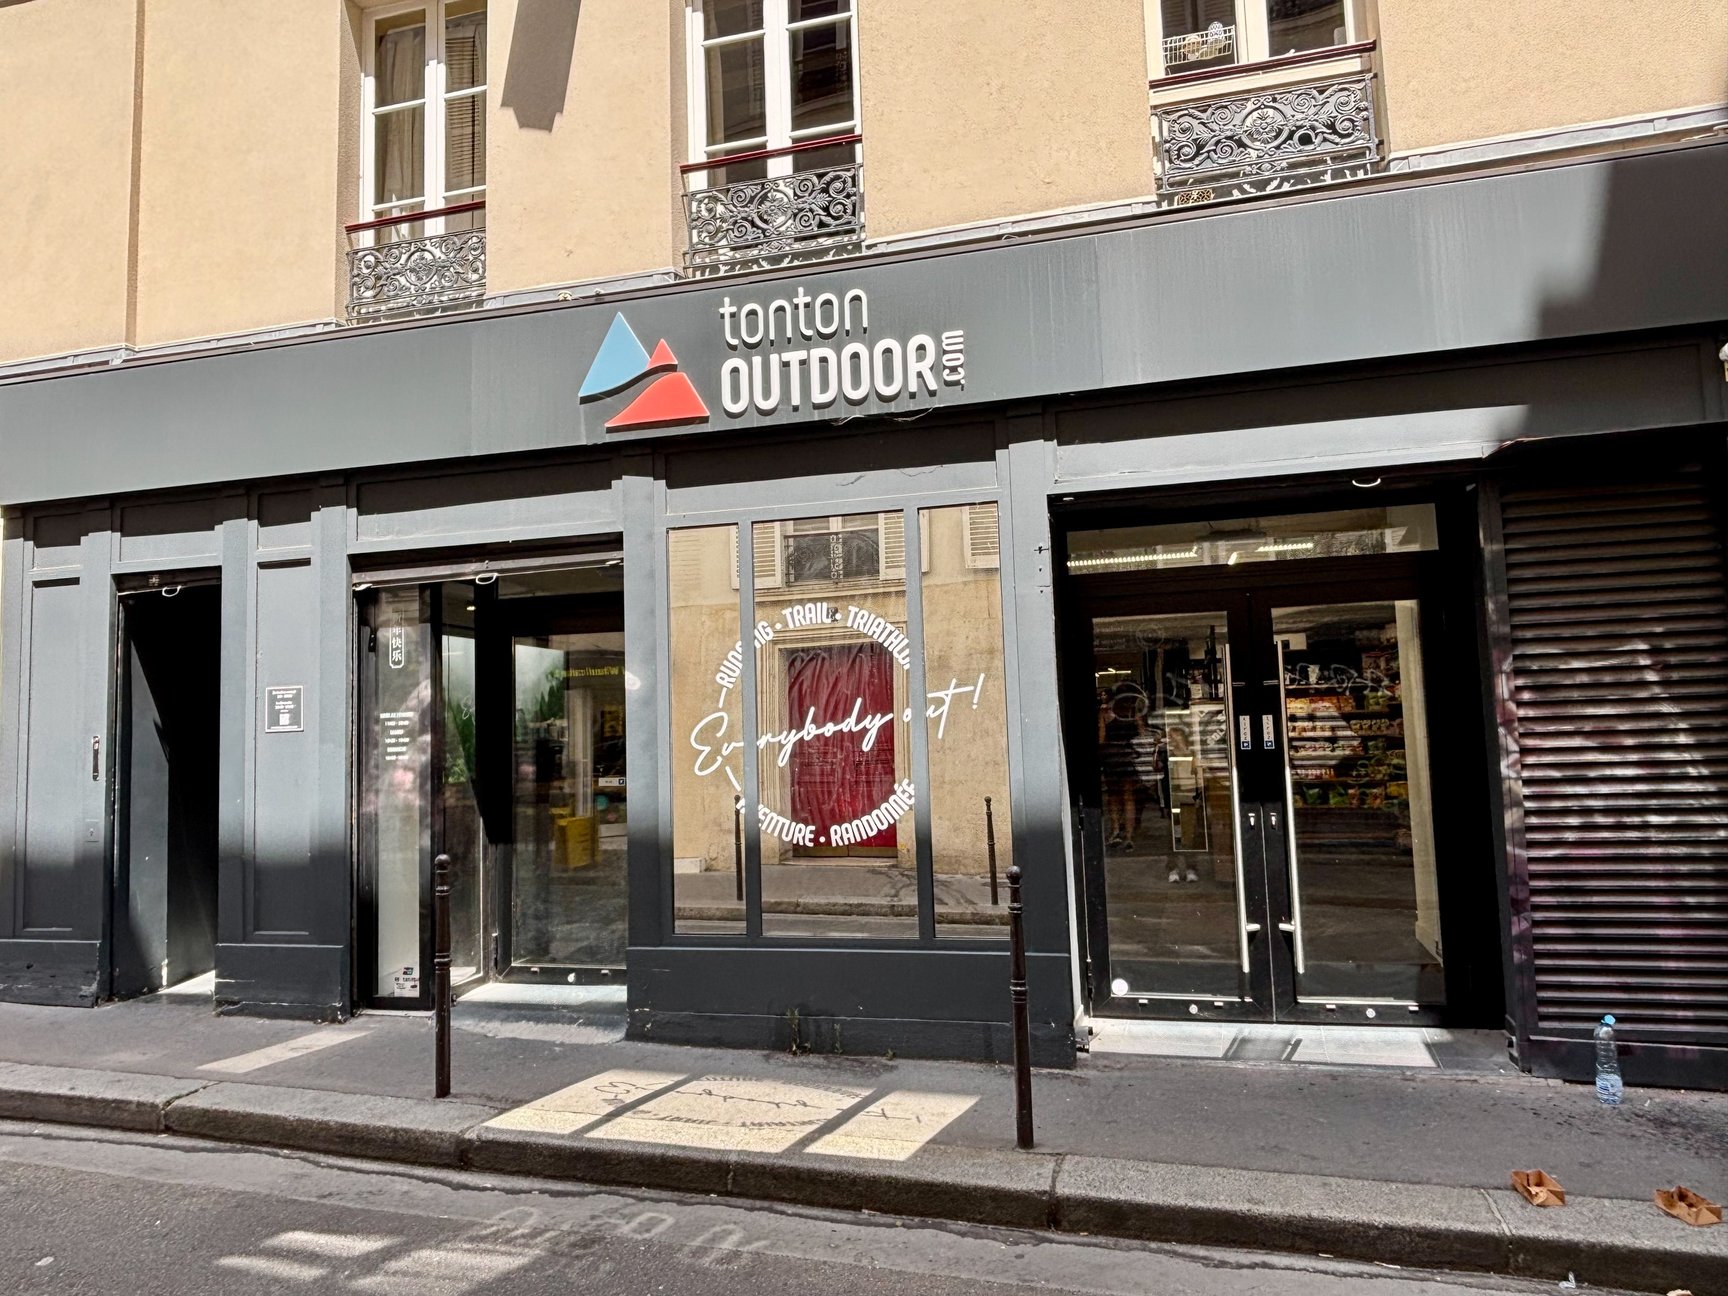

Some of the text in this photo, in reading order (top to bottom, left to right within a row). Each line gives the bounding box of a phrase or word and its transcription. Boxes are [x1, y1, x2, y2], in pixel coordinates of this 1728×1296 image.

[719, 287, 868, 347] tonton
[721, 334, 938, 414] OUTDOOR
[941, 330, 966, 385] .com
[716, 602, 910, 689] RUNNG TRAIL TRIATHLO
[690, 698, 894, 776] Evrybody
[736, 778, 915, 847] AENTURE RANDONNÉE
